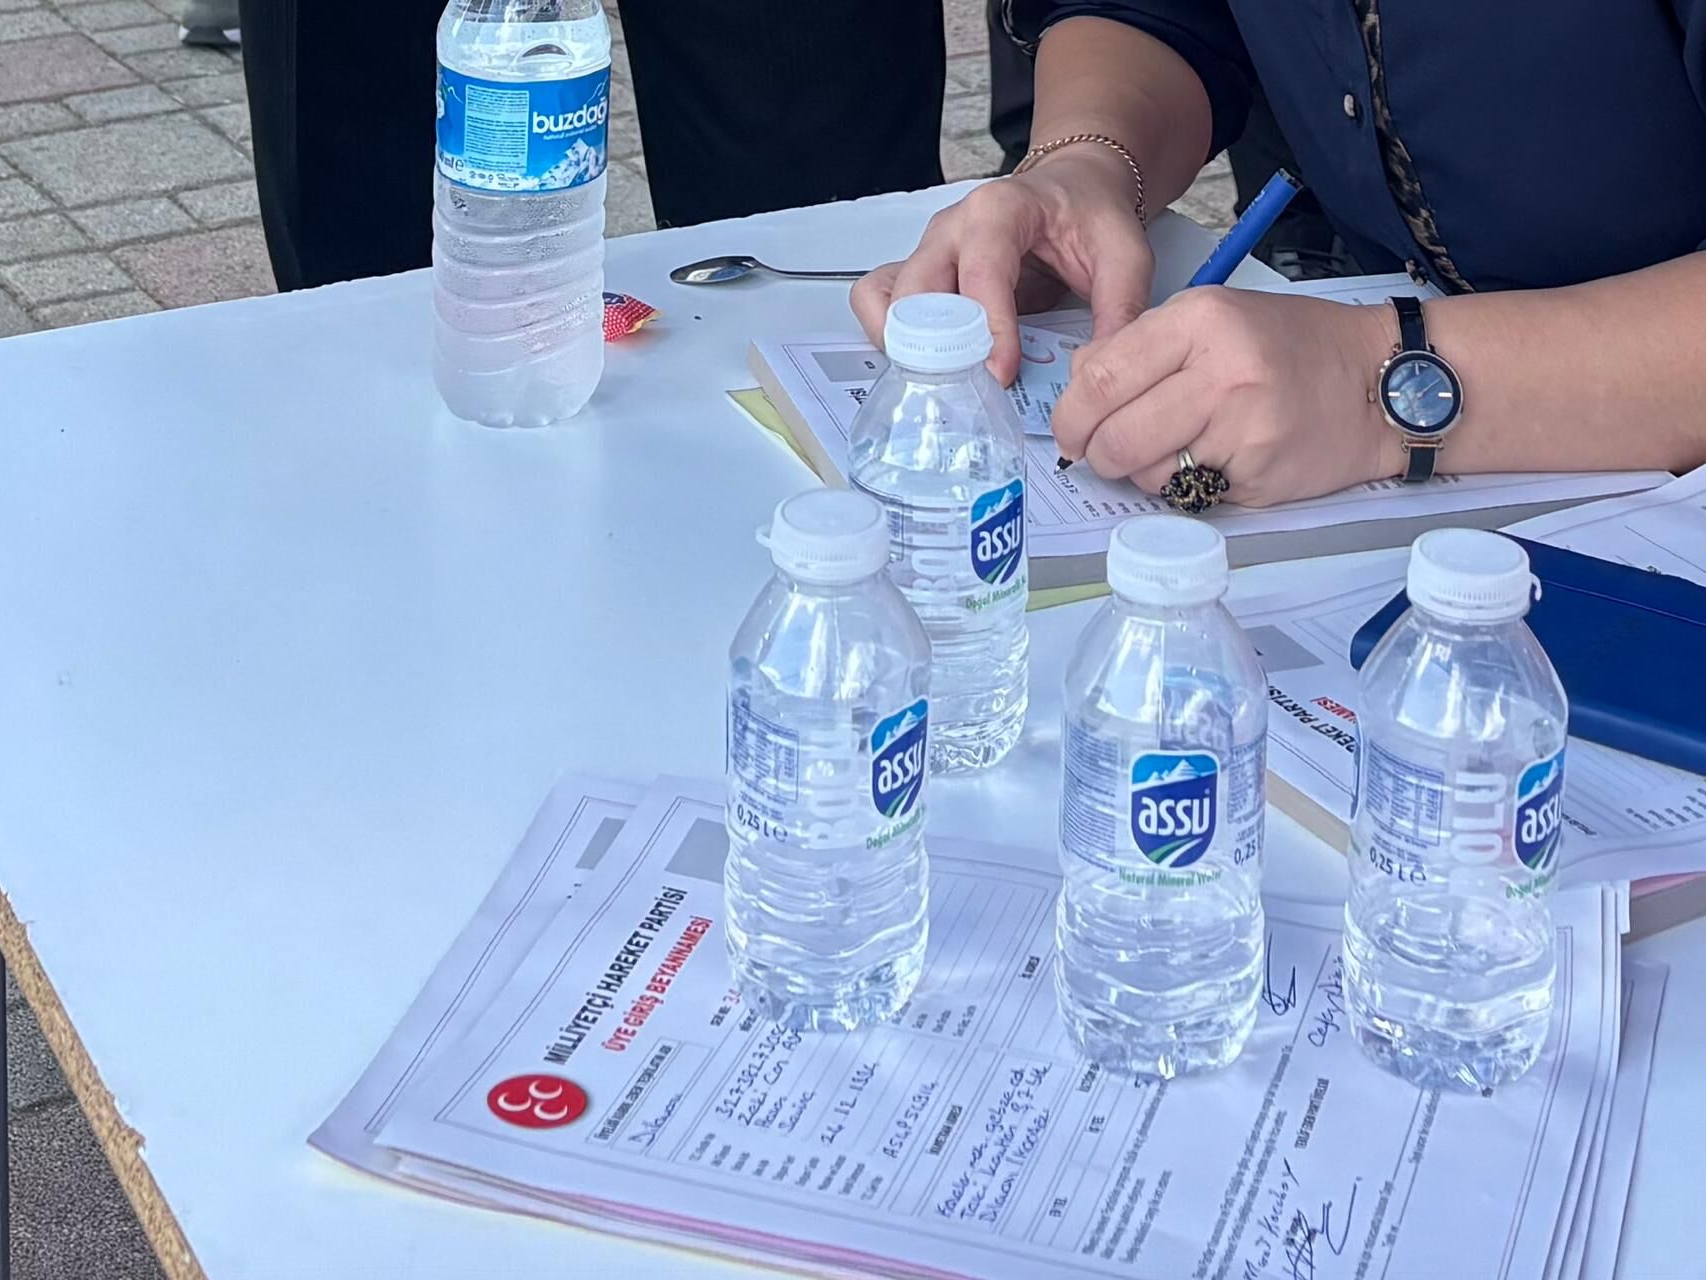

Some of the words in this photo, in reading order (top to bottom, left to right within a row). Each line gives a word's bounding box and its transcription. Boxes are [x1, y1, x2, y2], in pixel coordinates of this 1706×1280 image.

[977, 515, 1021, 562] assu
[878, 737, 924, 795] assu
[1138, 796, 1212, 837] assu
[543, 991, 615, 1067] MİLLİYETÇİ
[596, 930, 655, 994] HAREKET
[638, 885, 689, 933] PARTİSİ
[601, 1025, 638, 1053] ÜYE
[623, 994, 665, 1028] GİRİŞ
[645, 915, 714, 996] BEYANNAMESİ
